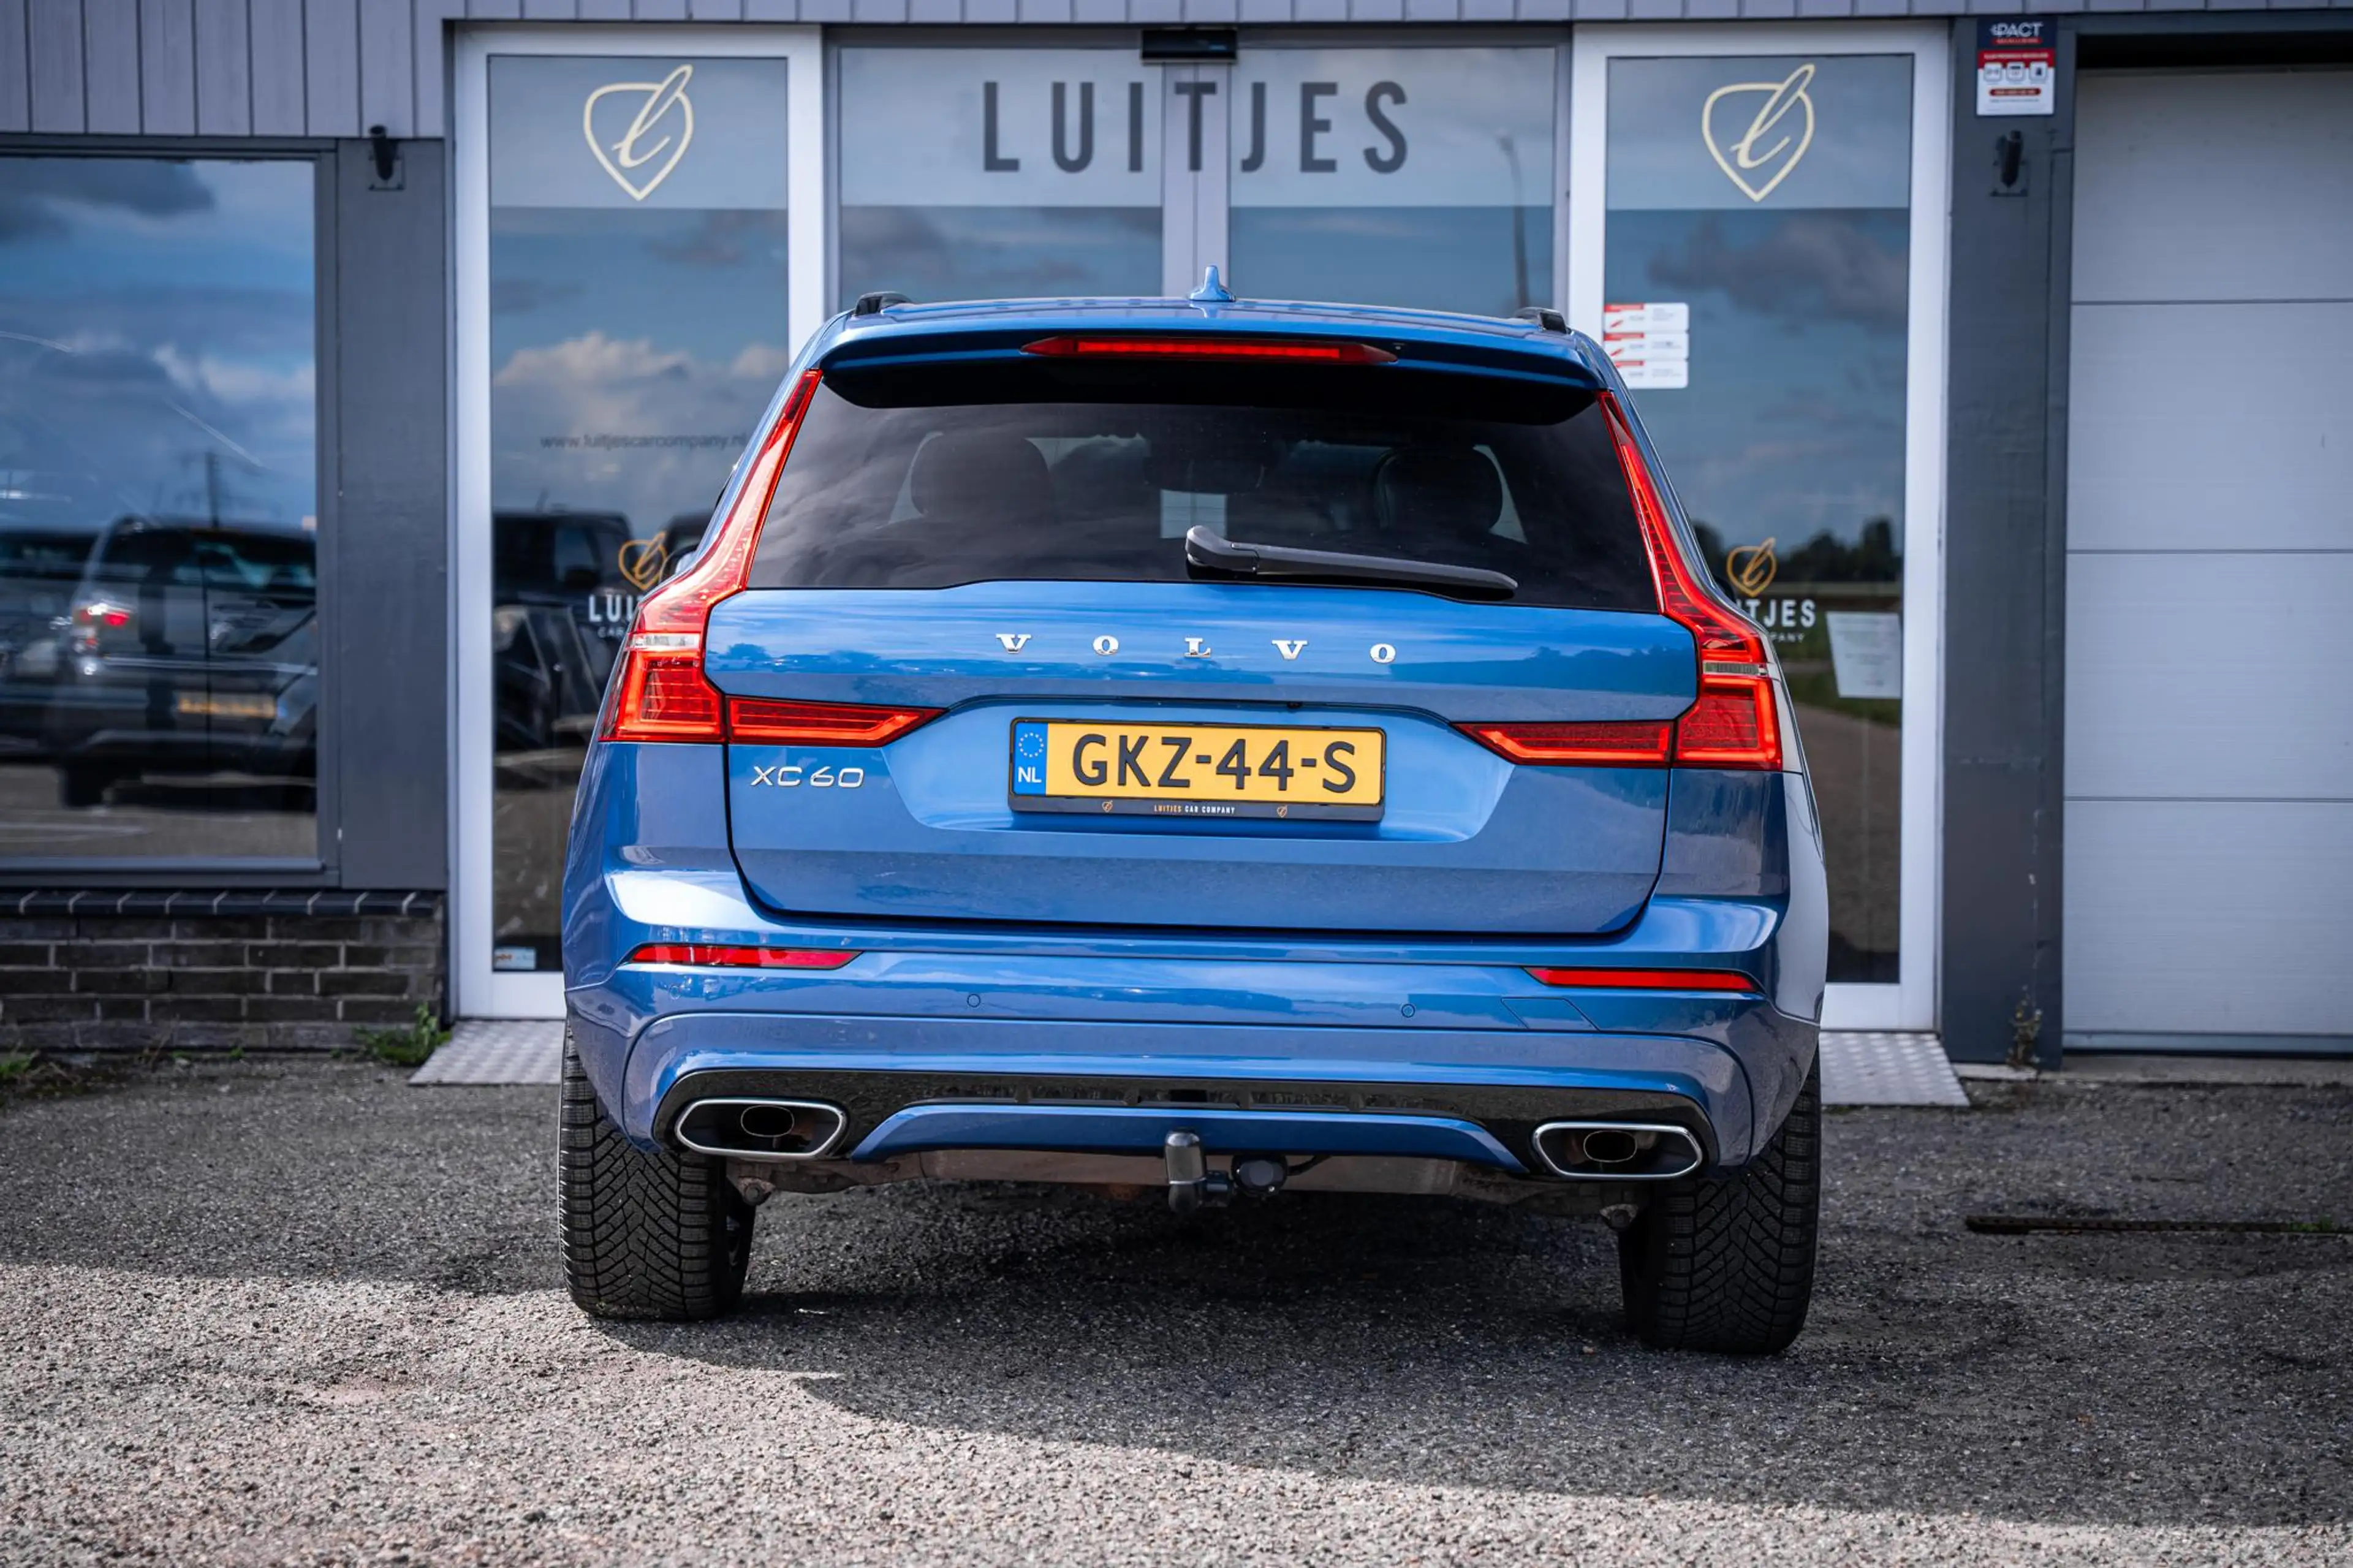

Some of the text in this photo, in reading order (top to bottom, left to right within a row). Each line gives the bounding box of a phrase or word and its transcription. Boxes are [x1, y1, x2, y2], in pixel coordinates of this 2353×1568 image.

[983, 80, 1408, 174] LUITJES
[995, 633, 1397, 664] VOLVO
[1018, 767, 1042, 784] NL
[1072, 733, 1356, 793] GKZ-44-S
[1154, 804, 1235, 814] LUITJES CAR COMPANY
